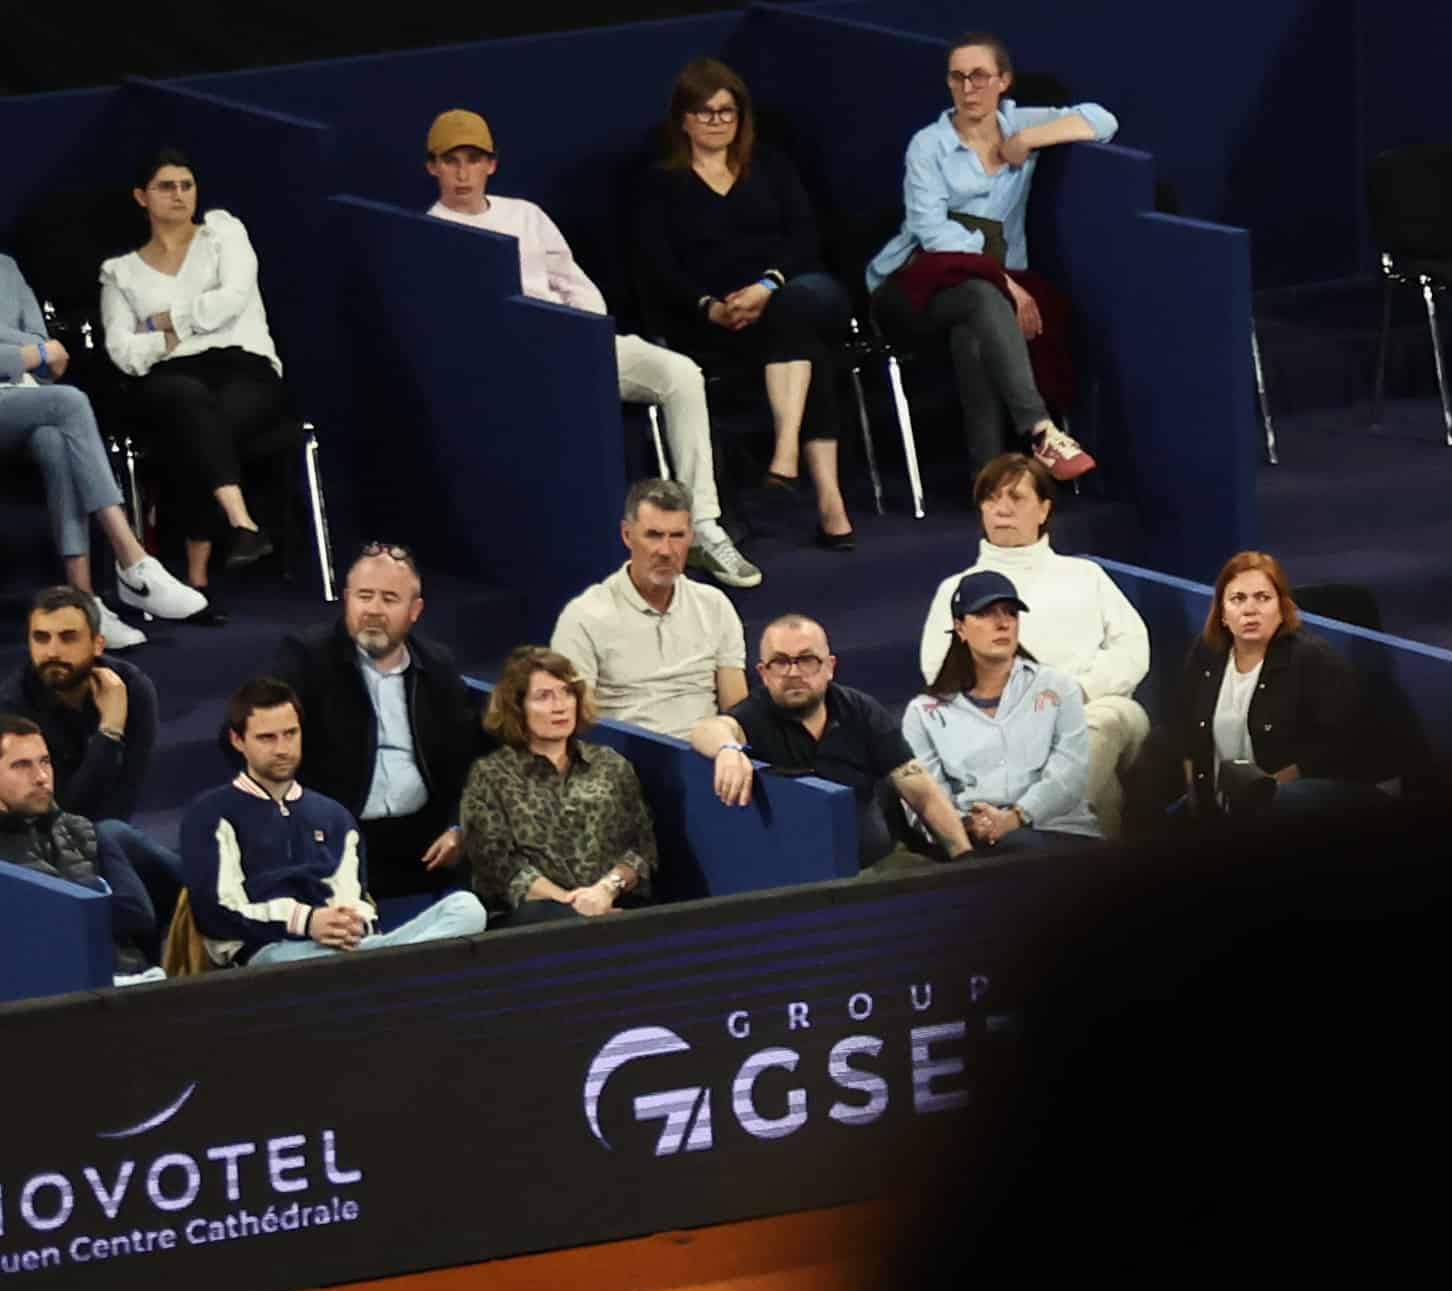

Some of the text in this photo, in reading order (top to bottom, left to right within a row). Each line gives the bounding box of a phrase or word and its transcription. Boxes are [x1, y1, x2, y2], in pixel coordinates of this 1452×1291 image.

[726, 975, 991, 1039] GROUP
[731, 1013, 1014, 1140] GSE
[0, 1129, 362, 1237] OVOTEL
[0, 1196, 360, 1273] uen Centre Cathédrale
